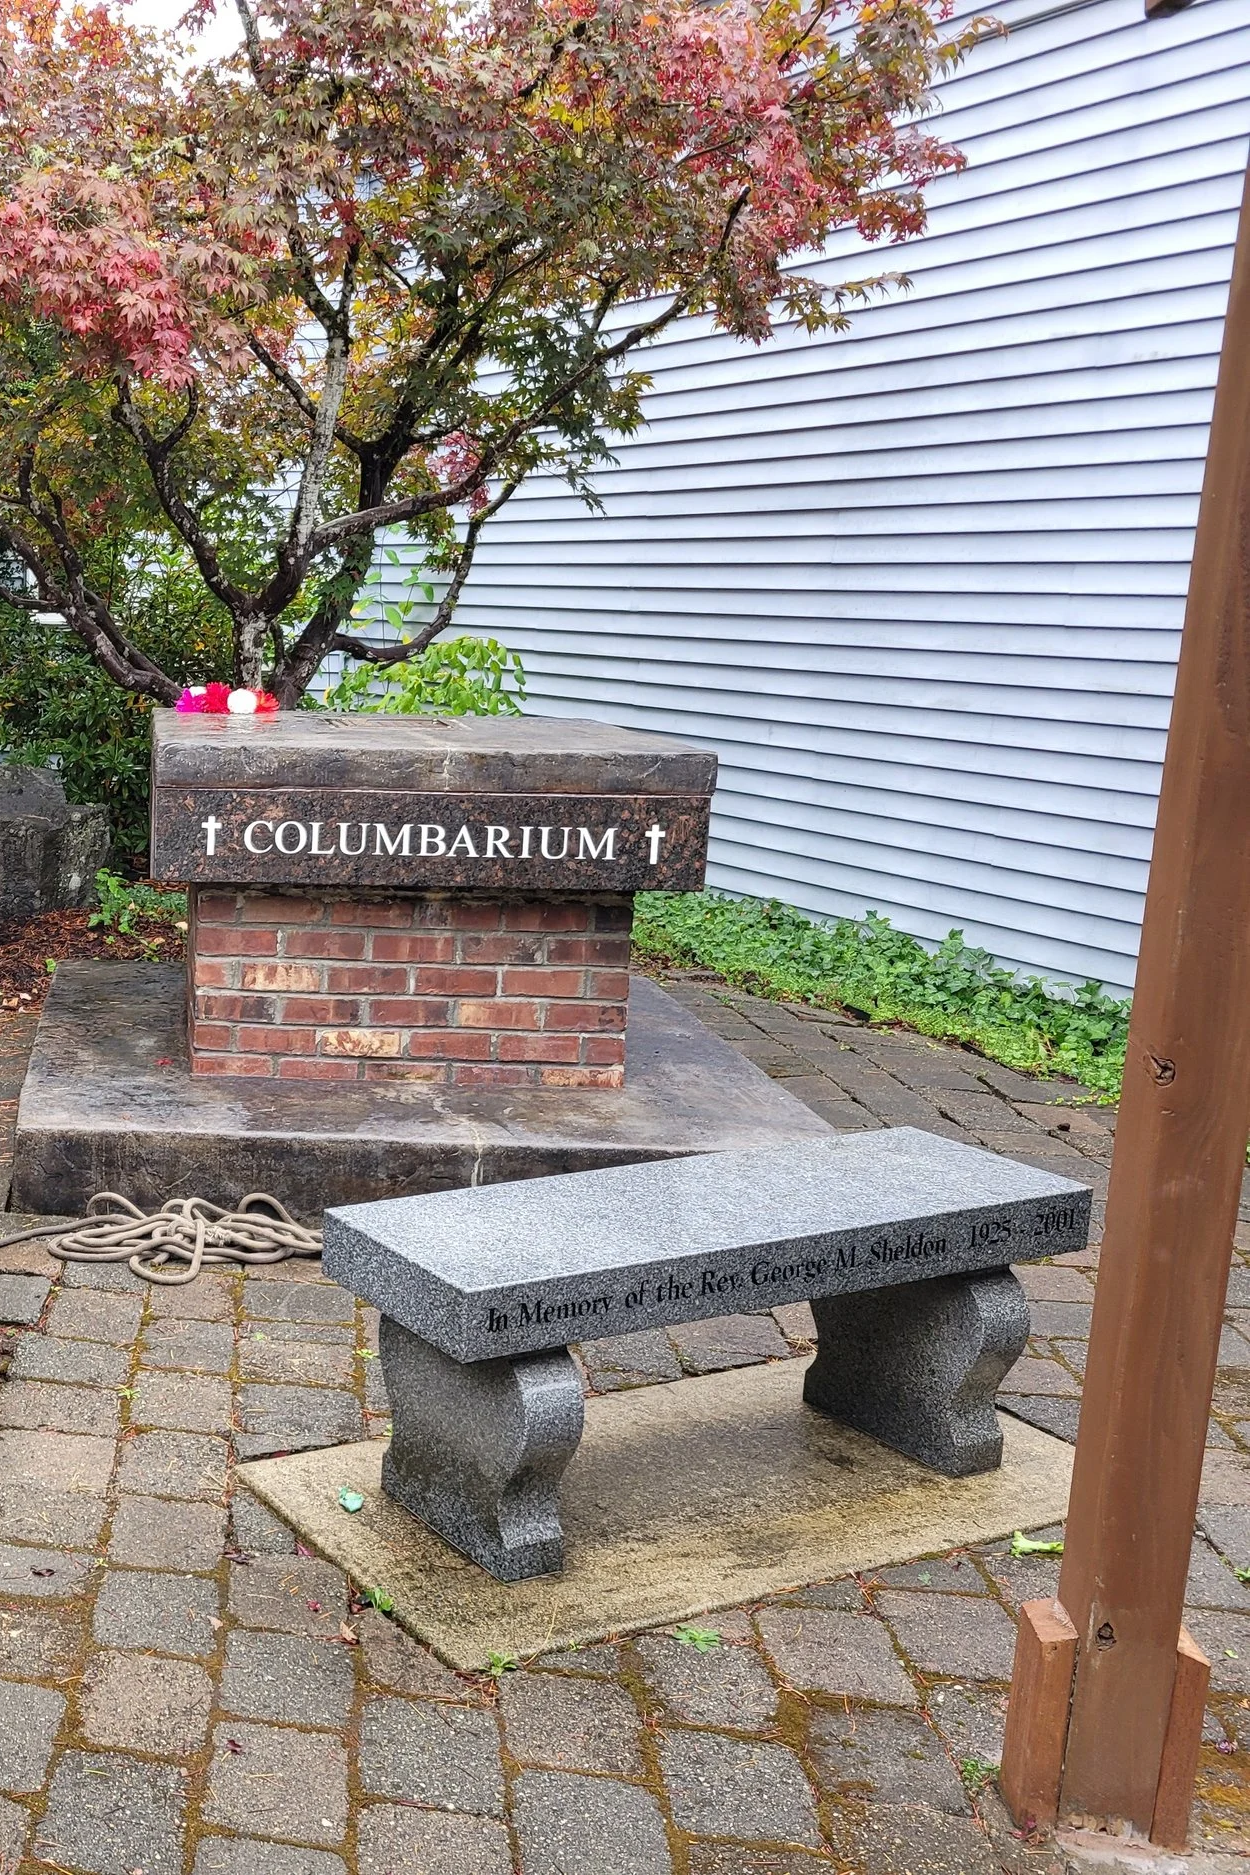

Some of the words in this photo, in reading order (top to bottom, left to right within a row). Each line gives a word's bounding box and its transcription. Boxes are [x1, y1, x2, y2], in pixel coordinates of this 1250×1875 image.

[243, 819, 619, 861] COLUMBARIUM
[487, 1307, 508, 1333] In
[519, 1294, 613, 1327] Memory
[625, 1280, 649, 1309] of
[657, 1275, 693, 1301] the
[751, 1257, 827, 1286] George
[868, 1232, 947, 1266] Sheldon
[1033, 1206, 1076, 1237] 2001
